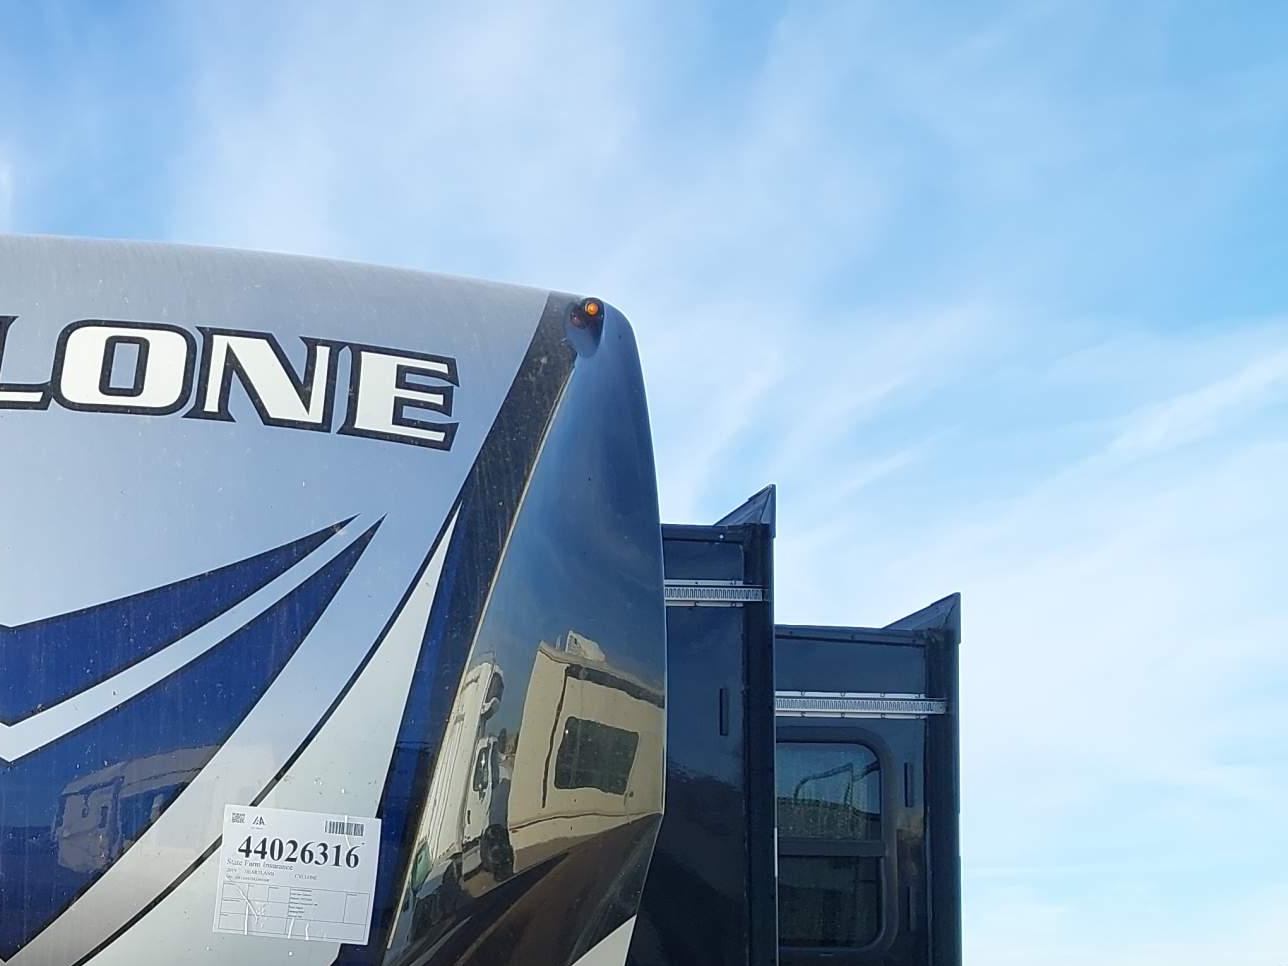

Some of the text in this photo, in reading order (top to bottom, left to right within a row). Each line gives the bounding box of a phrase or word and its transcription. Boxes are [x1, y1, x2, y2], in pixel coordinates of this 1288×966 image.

[238, 836, 361, 868] 44026316
[245, 860, 261, 868] Farm
[263, 861, 294, 871] Insurance
